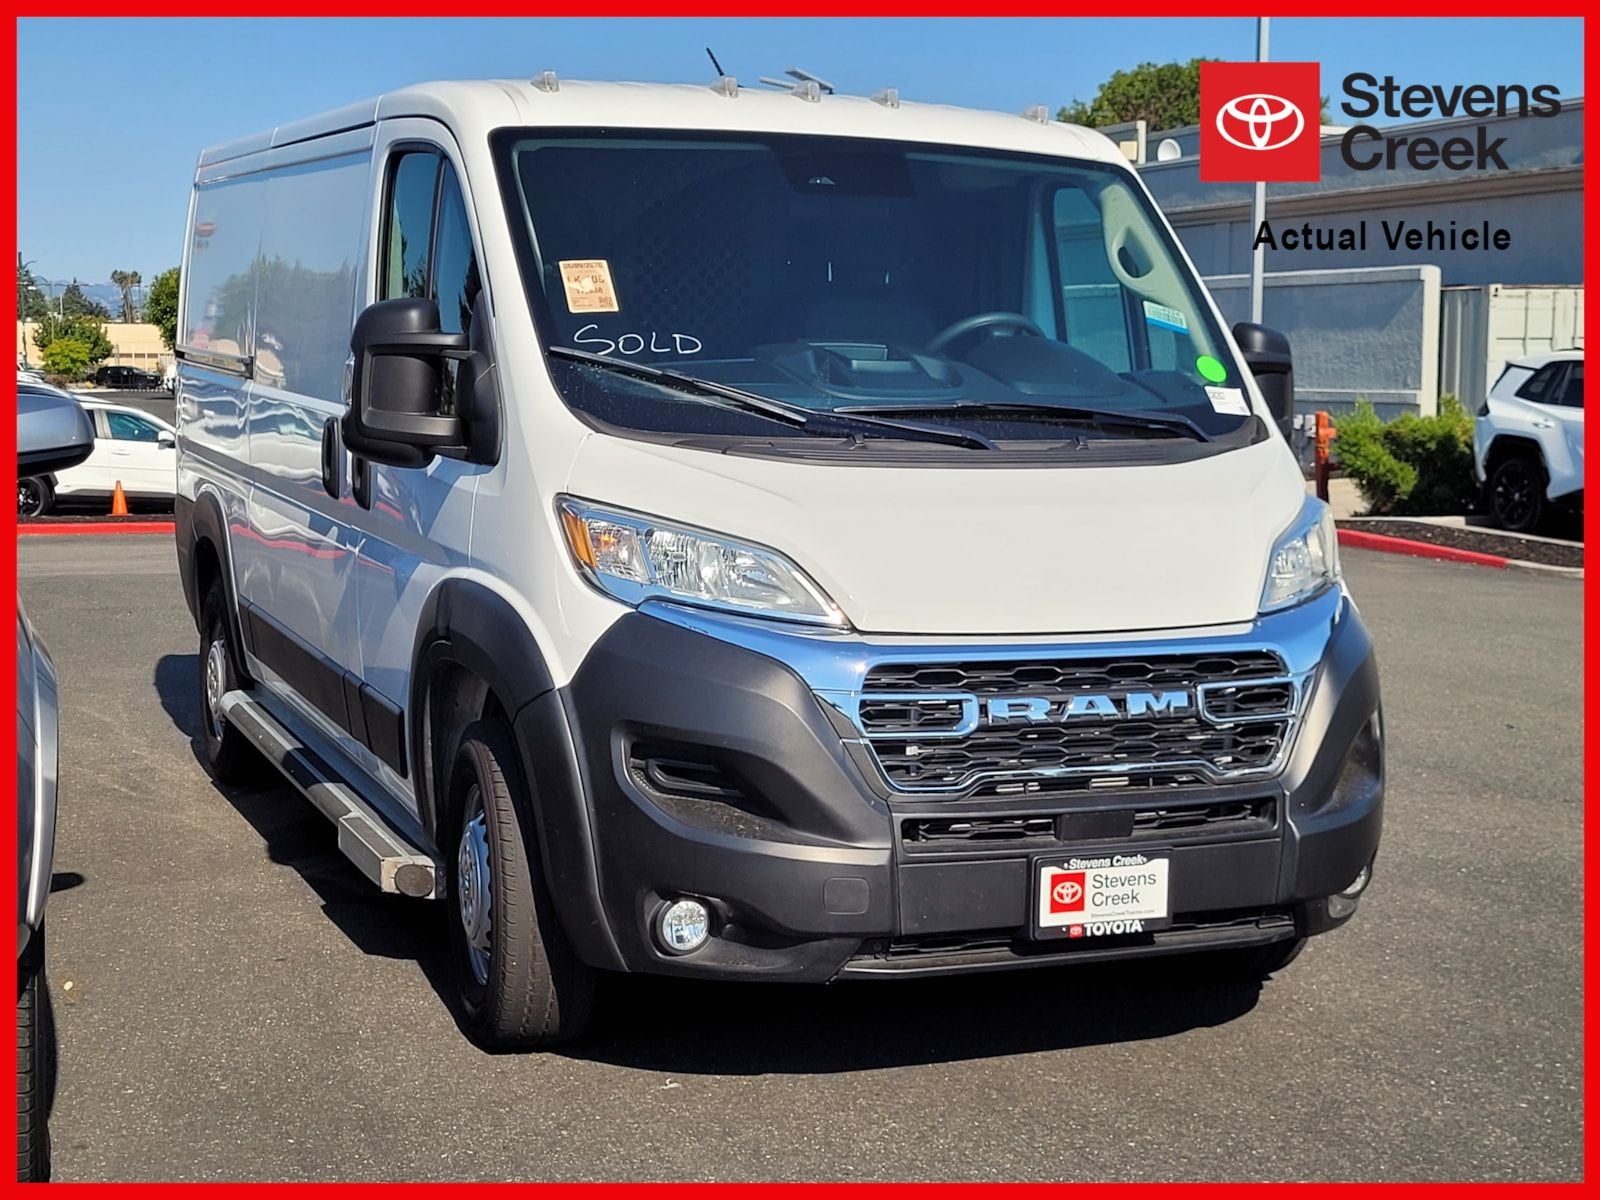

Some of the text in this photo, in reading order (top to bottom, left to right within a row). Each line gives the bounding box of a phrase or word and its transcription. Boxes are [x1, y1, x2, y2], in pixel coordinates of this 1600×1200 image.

[573, 324, 702, 355] SOLD
[989, 691, 1190, 726] RAM
[1068, 854, 1143, 870] Stevens Creek
[1092, 873, 1157, 889] Stevens
[1092, 889, 1140, 907] Creek
[1084, 920, 1143, 937] TOYOTA
